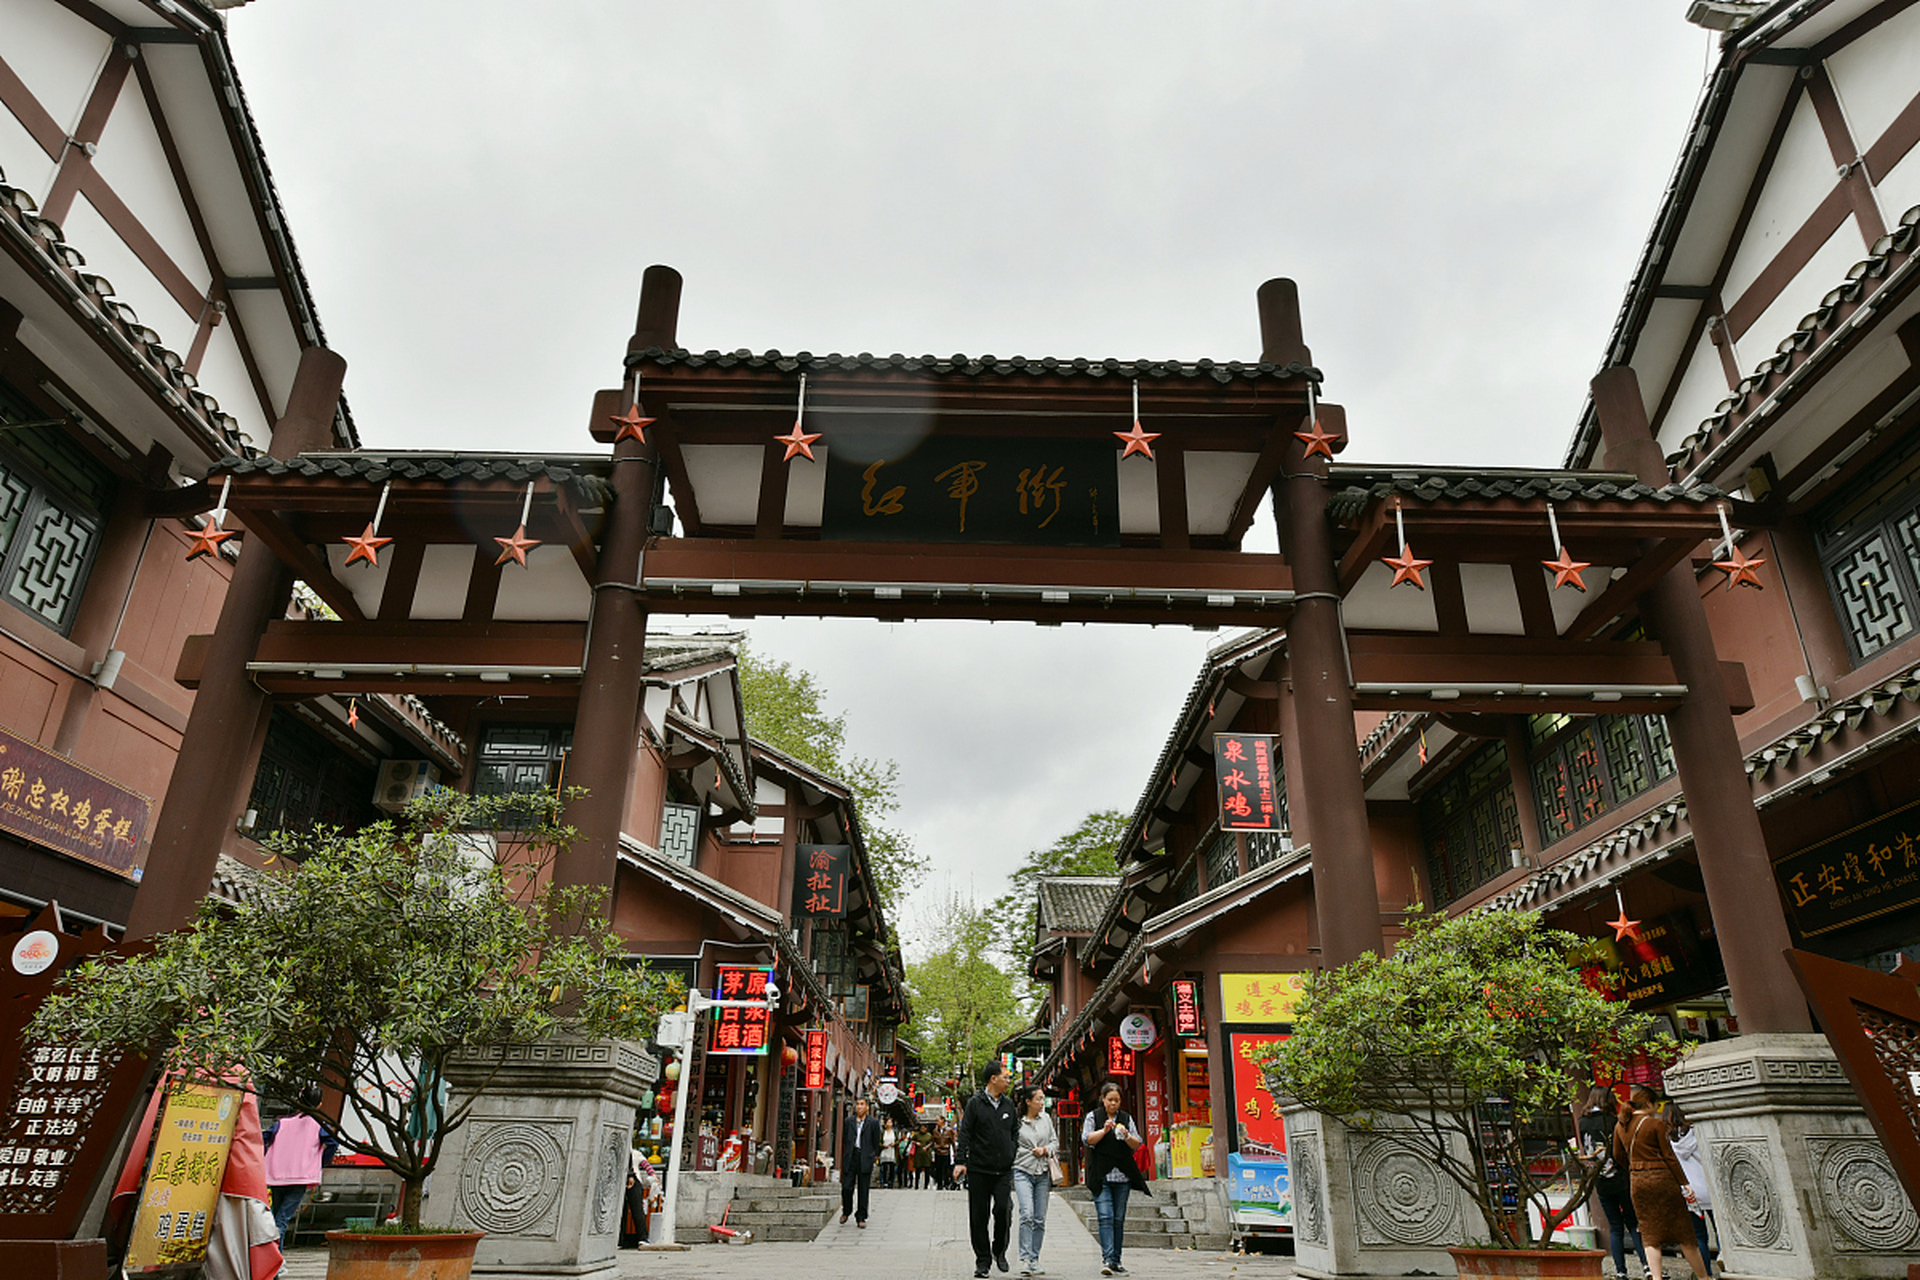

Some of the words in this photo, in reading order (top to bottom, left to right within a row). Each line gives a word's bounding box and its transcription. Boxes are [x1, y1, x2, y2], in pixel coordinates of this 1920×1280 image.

[1223, 738, 1252, 817] 泉水鸡
[1, 766, 133, 843] 谢忠权鸡蛋糕
[1246, 980, 1289, 997] 遵义
[718, 970, 746, 1048] 茅台镇
[33, 1047, 102, 1064] 富强民主
[30, 1065, 100, 1083] 文明和谐
[10, 1118, 79, 1136] 正法治
[154, 1210, 207, 1241] 鸡蛋糕
